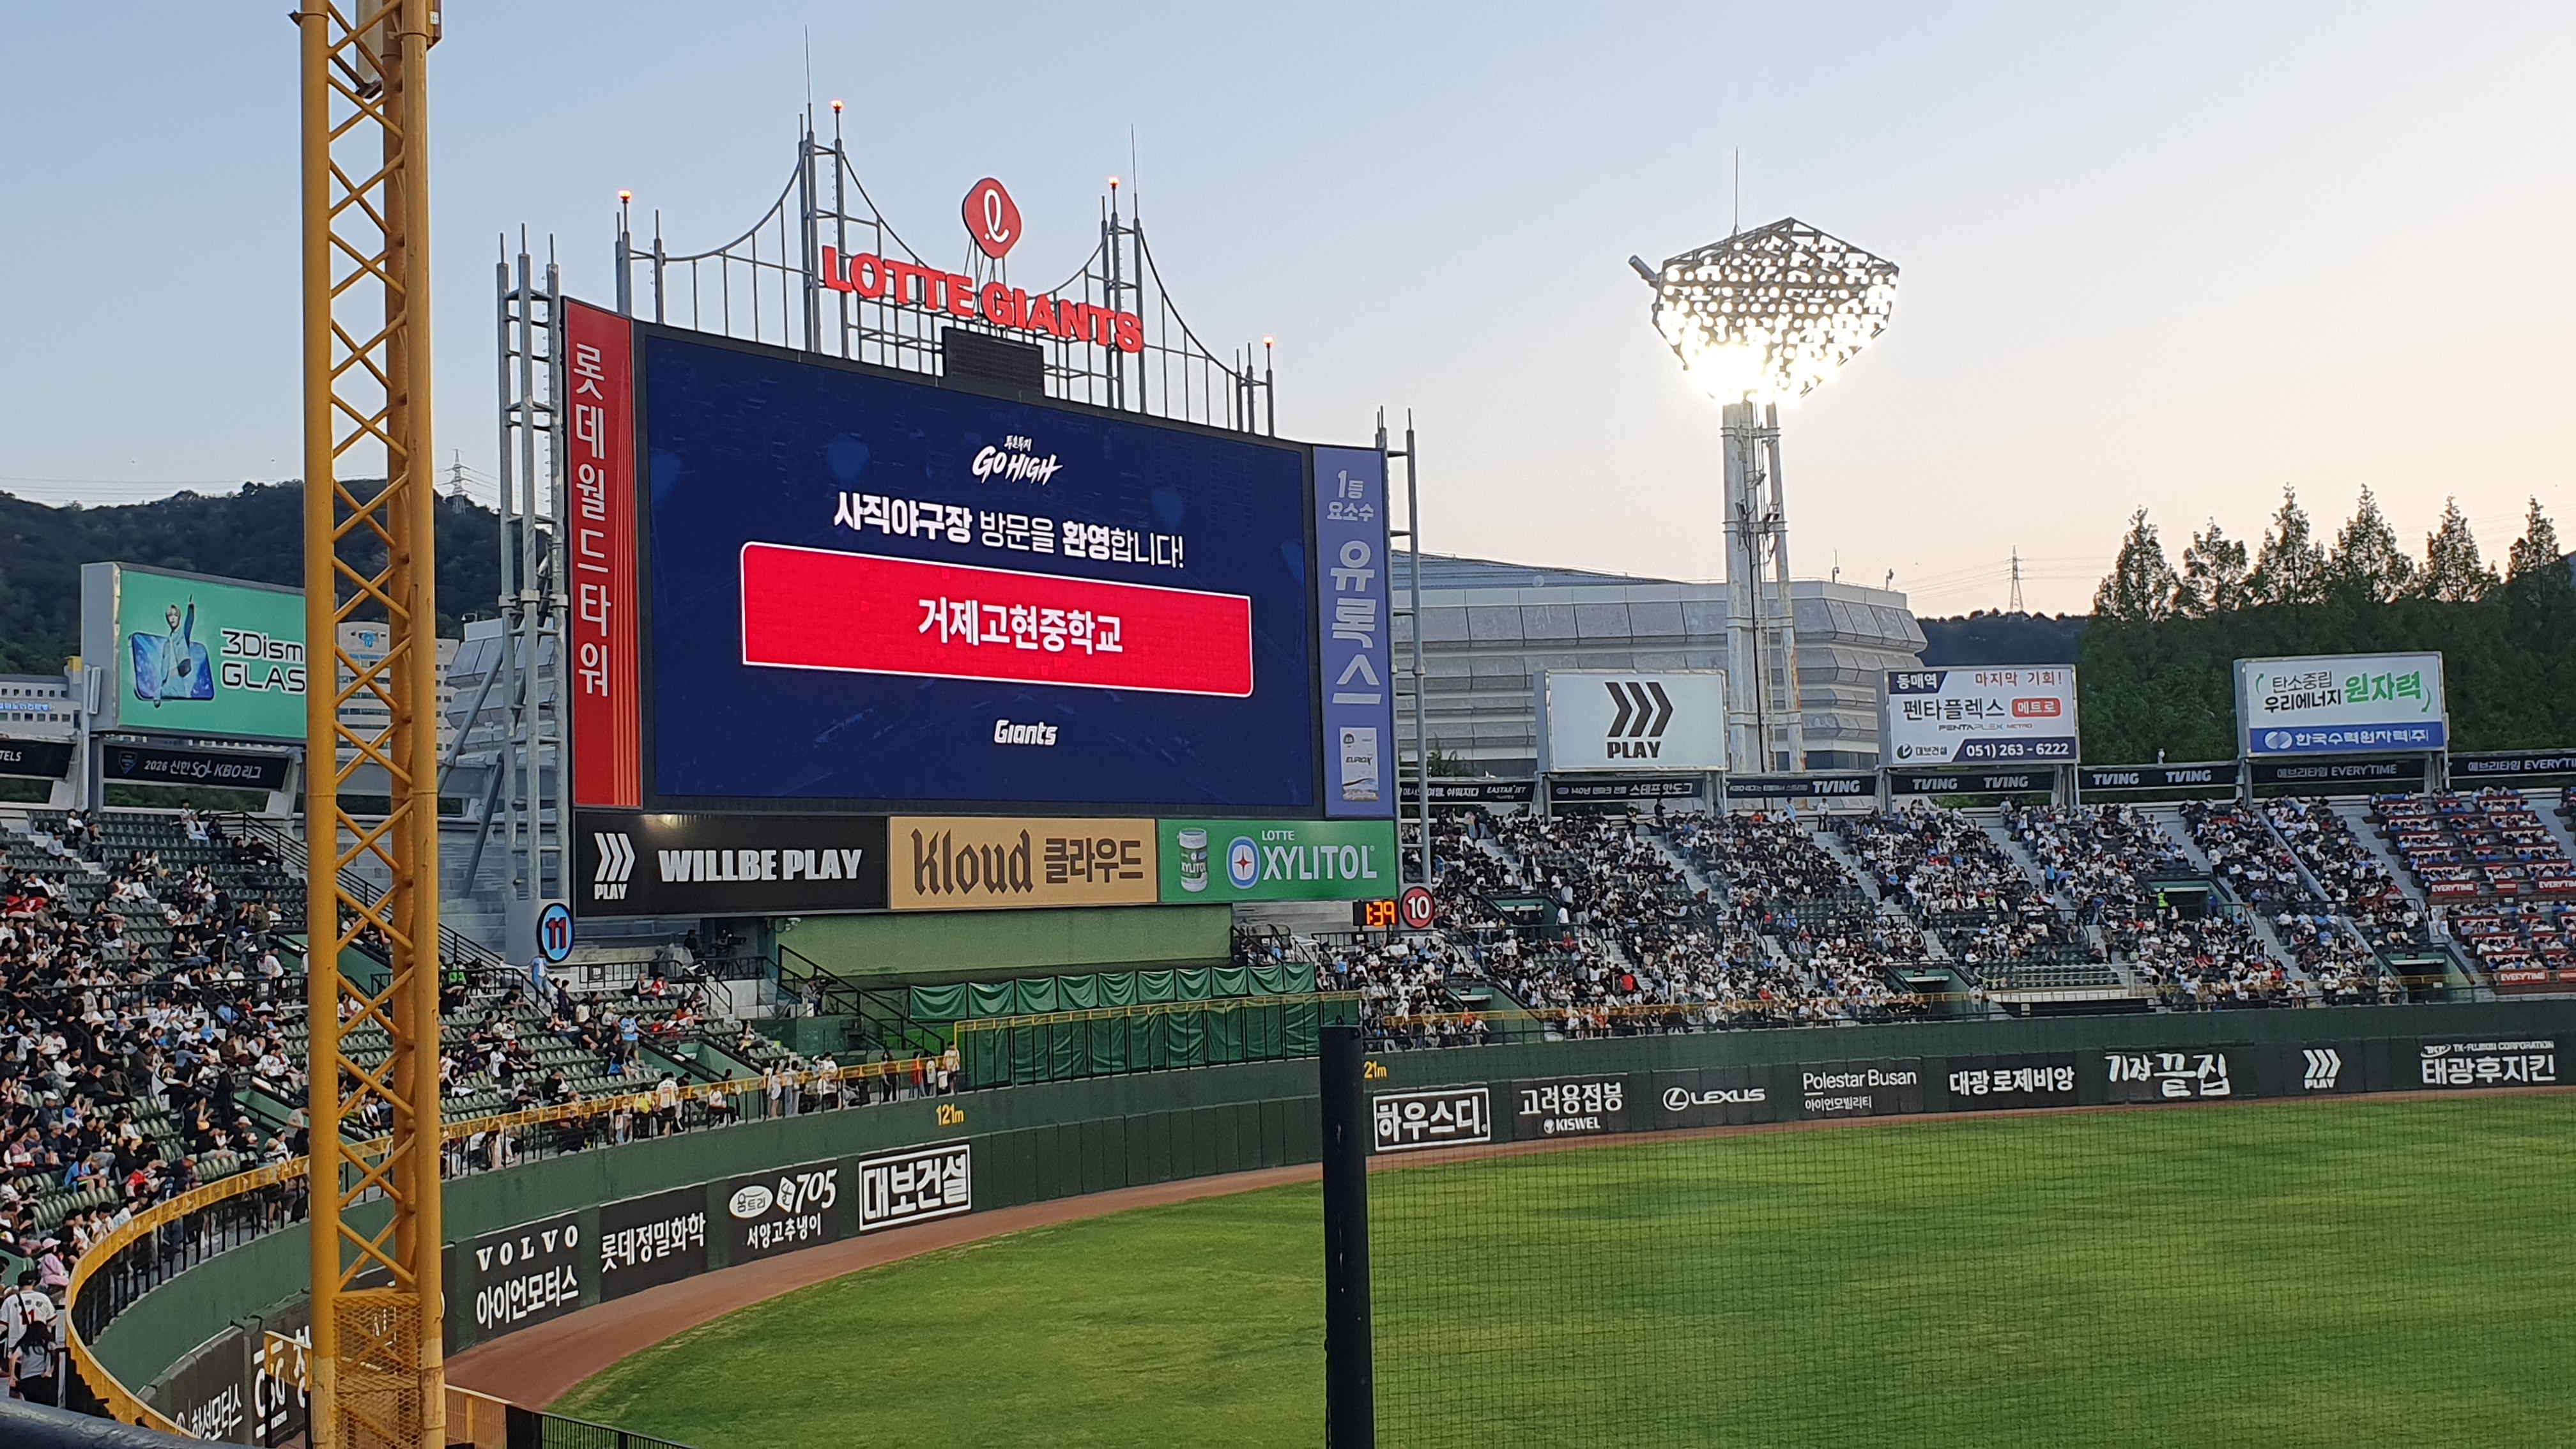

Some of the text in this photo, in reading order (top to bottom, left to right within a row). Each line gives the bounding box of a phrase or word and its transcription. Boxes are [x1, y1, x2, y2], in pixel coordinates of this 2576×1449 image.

[822, 245, 1144, 353] LOTTE GIANTS
[972, 445, 1064, 486] GO HIGH
[1337, 470, 1363, 500] 1등
[574, 342, 611, 697] 롯데월드타워
[1326, 502, 1374, 522] 요소수
[834, 491, 1184, 568] 사직야구장 방문을 환영합니다!
[918, 597, 1123, 655] 거제고현중학교
[1330, 540, 1381, 705] 유록스
[222, 631, 303, 662] 3Dism
[222, 663, 305, 692] GLAS
[1896, 673, 1937, 690] 동매역
[1975, 671, 2062, 687] 마지막 기회!
[2273, 671, 2332, 693] 탄소중립
[2345, 670, 2421, 703] 원자력
[1903, 698, 2005, 721] 펜타플렉스
[2018, 701, 2056, 714] 메트로
[2264, 689, 2342, 713] 우리에너지
[995, 720, 1058, 746] Giants
[1606, 742, 1661, 758] PLAY
[144, 760, 167, 770] 2026
[1813, 780, 1860, 793] TVING
[1912, 776, 2028, 790] TVING TVING
[2092, 770, 2211, 785] TVING TVING
[1262, 830, 1295, 841] LOTTE
[658, 849, 862, 882] WILLBE PLAY
[911, 828, 1144, 895] Kloud 클라우드
[594, 884, 627, 900] PLAY
[1366, 901, 1395, 926] 1:39
[1407, 896, 1430, 919] 10
[546, 916, 567, 951] 11
[1363, 1060, 1387, 1078] 21m
[1802, 1069, 1917, 1090] Polestar Busan
[2421, 1054, 2556, 1085] 태광후지킨
[2304, 1078, 2334, 1089] PLAY
[1519, 1082, 1623, 1116] 고려용접봉
[1690, 1089, 1765, 1105] LEXUS
[936, 1103, 965, 1126] 121m
[1556, 1116, 1600, 1131] KISWEL
[863, 1153, 967, 1220] 대보건설
[737, 1192, 765, 1213] 움트리
[601, 1212, 706, 1273] 롯데정밀화학
[747, 1213, 821, 1249] 서양고추냉이
[476, 1225, 578, 1271] VOLVO
[476, 1265, 579, 1329] 아이언모터스
